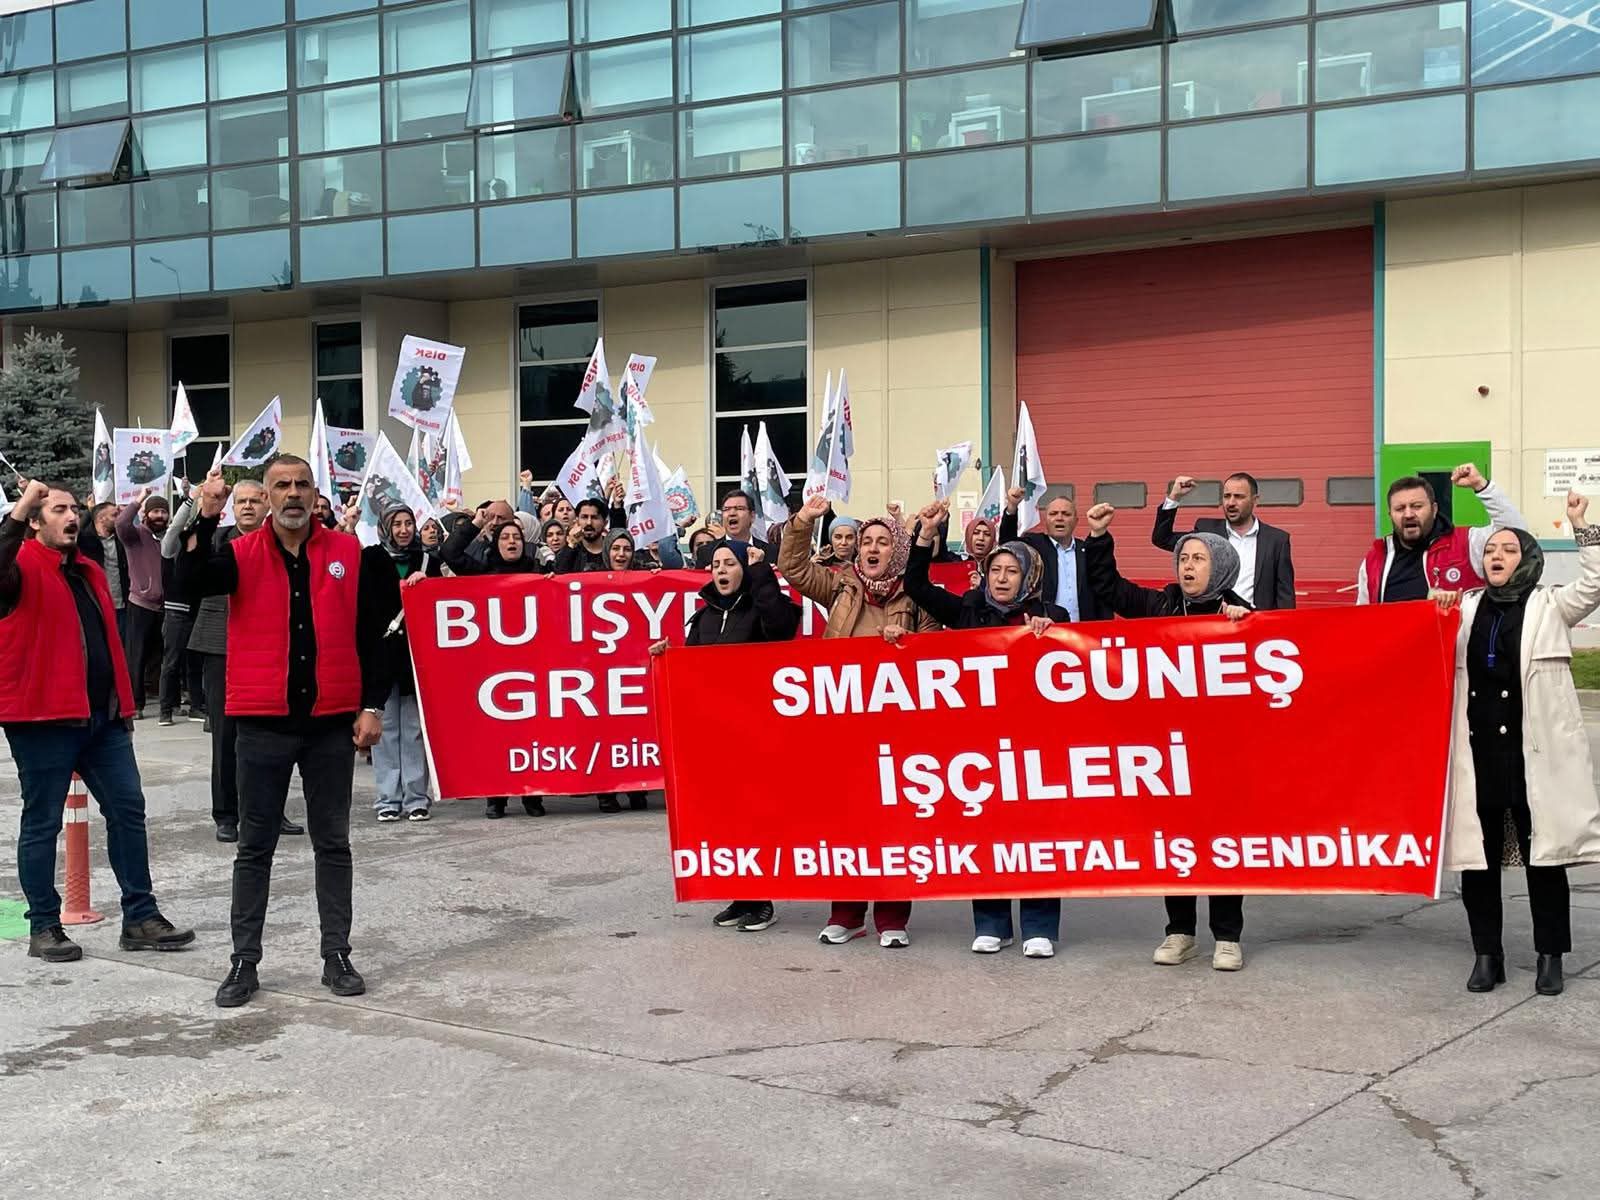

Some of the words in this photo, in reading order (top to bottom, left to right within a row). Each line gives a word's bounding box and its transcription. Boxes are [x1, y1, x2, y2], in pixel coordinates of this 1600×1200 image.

[436, 596, 537, 648] BU
[772, 655, 1008, 717] SMART
[1035, 636, 1304, 709] GÜNEŞ
[509, 741, 577, 772] DİSK
[586, 741, 601, 775] /
[878, 731, 1192, 818] İŞÇİLERİ
[675, 839, 764, 879] DİSK
[773, 847, 781, 877] /
[793, 837, 981, 884] BİRLEŞİK
[992, 839, 1140, 874] METAL
[1153, 830, 1198, 877] İŞ
